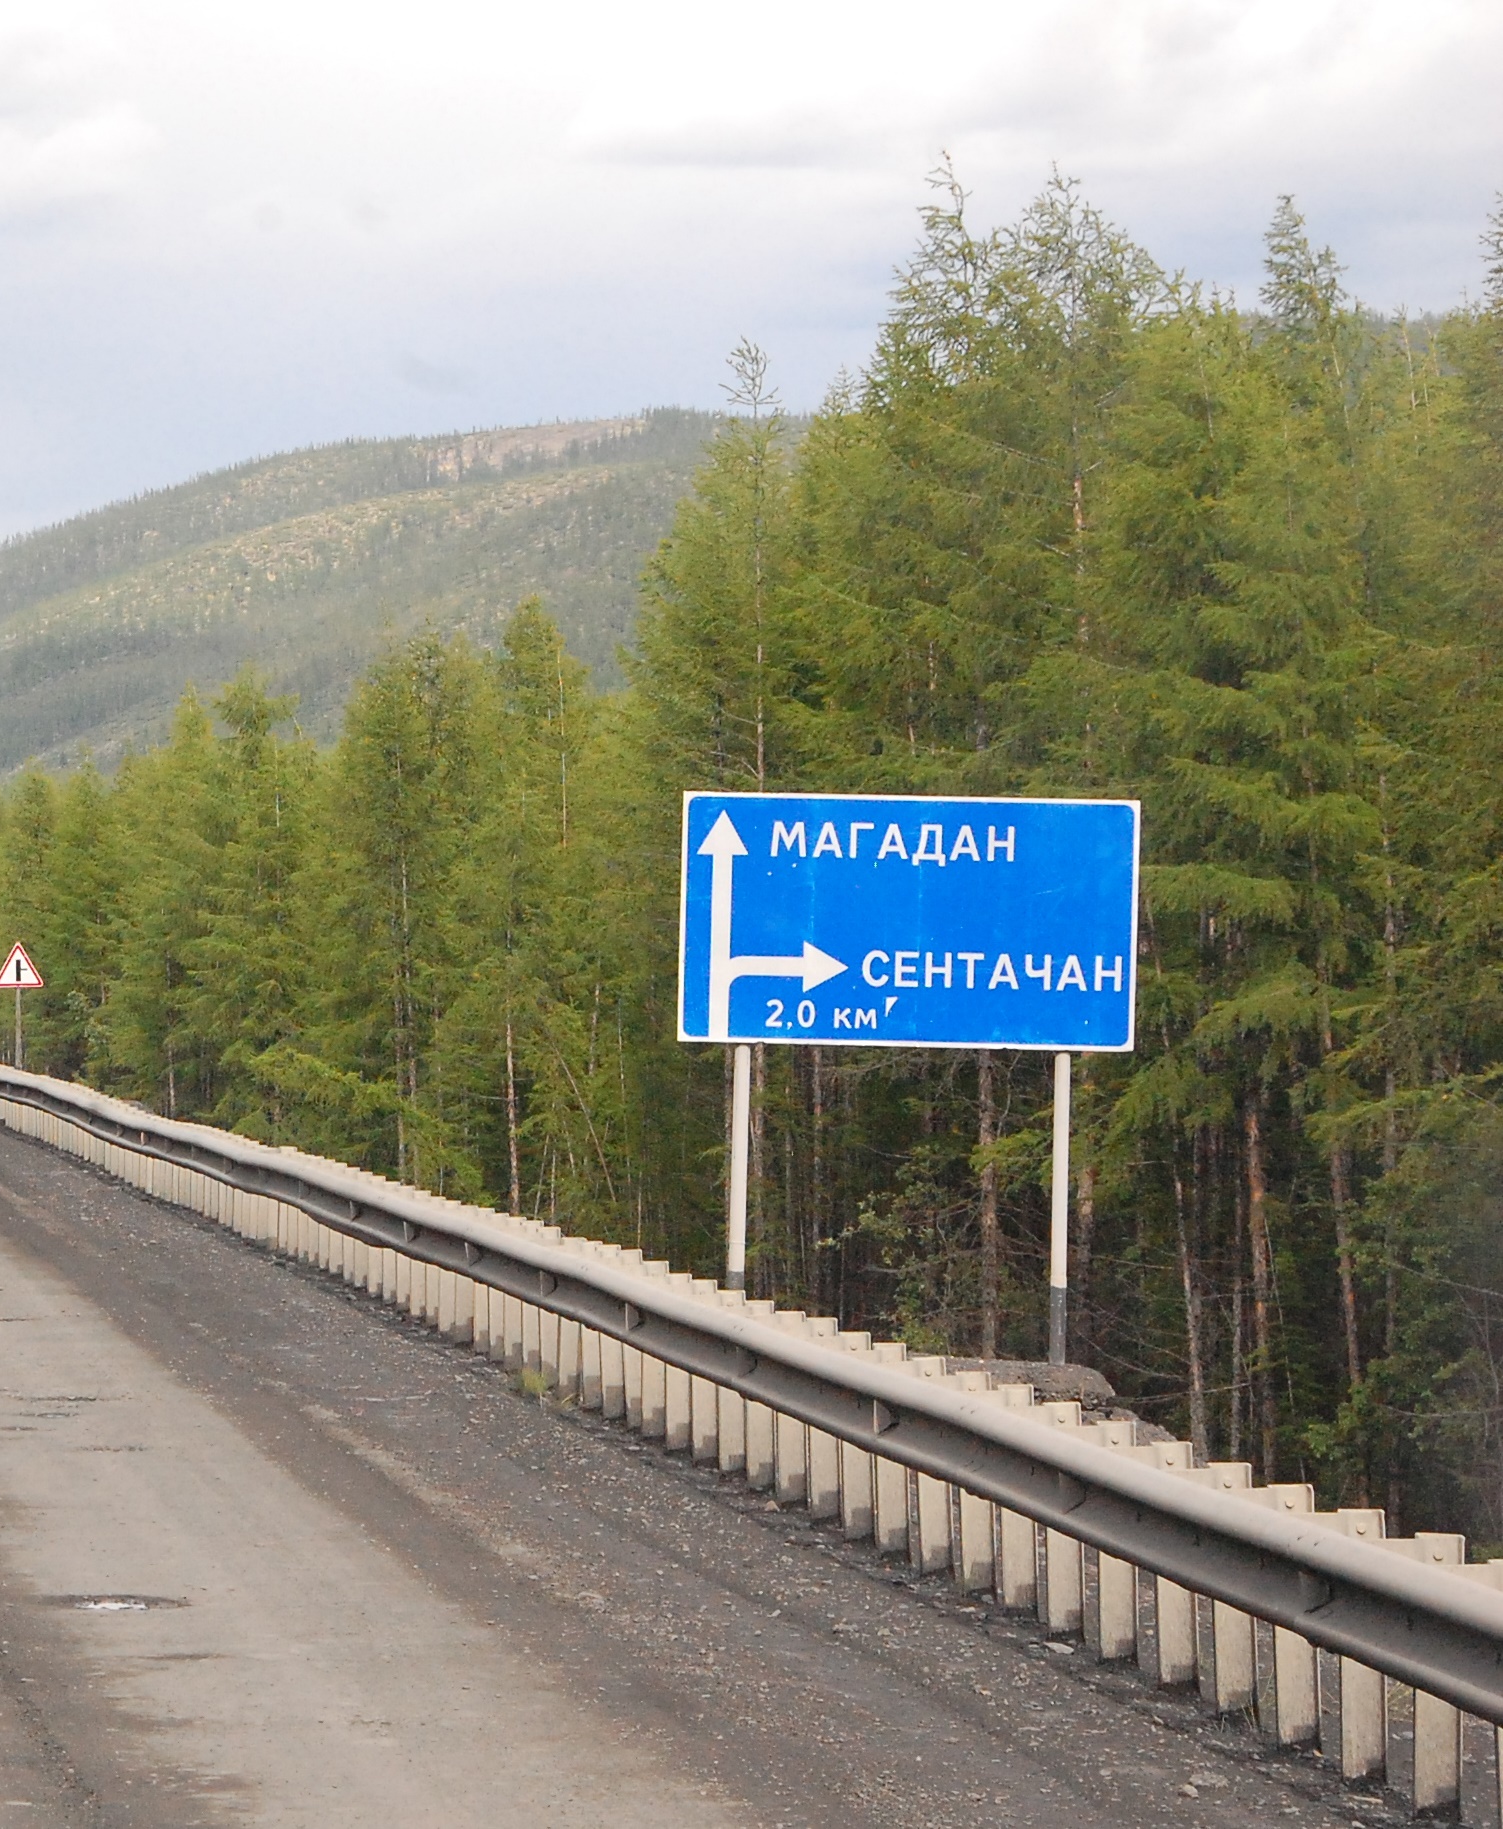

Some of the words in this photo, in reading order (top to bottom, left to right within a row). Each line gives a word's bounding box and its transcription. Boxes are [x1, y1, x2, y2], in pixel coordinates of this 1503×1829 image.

[770, 820, 1015, 867] МАГАДАН
[861, 949, 1124, 992] СЕНТАЧАН
[764, 998, 816, 1030] 2,0
[833, 1006, 878, 1029] км
